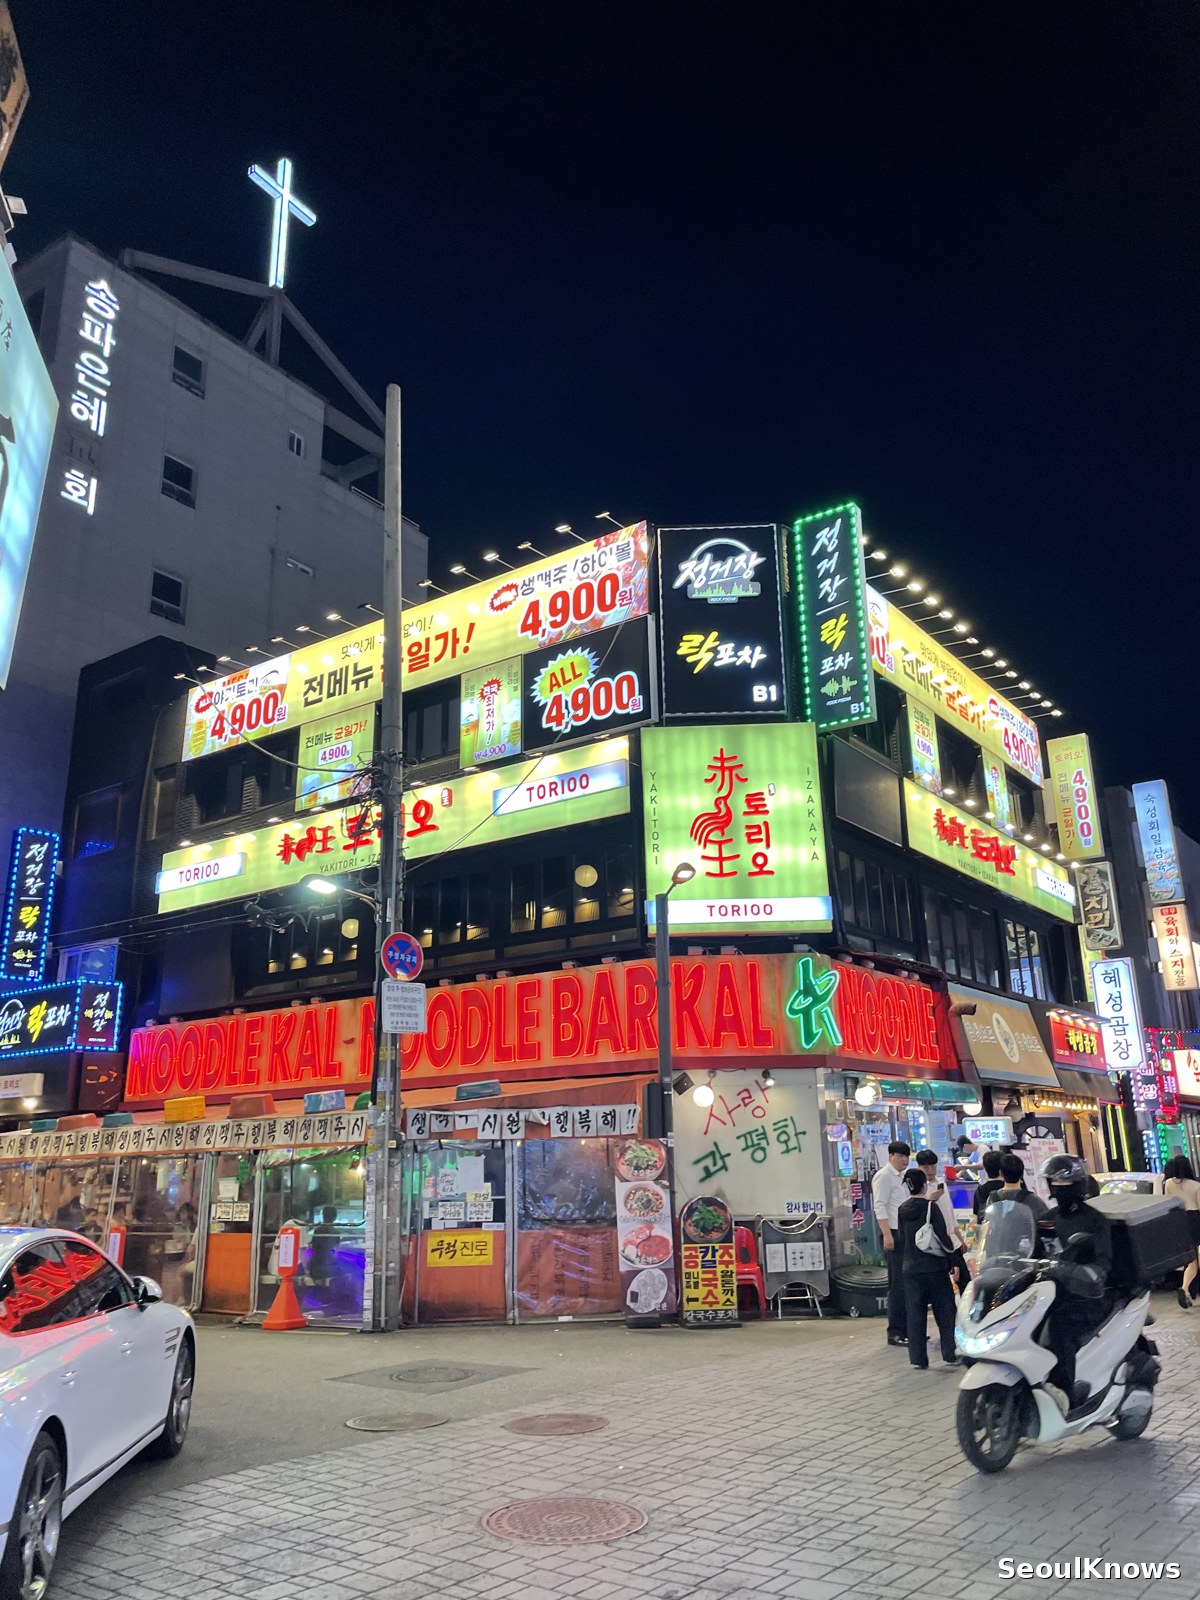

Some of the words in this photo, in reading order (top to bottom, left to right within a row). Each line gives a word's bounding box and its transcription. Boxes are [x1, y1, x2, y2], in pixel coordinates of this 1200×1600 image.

[672, 552, 767, 589] 정거장
[811, 517, 849, 603] 정거장
[519, 572, 635, 638] 4,900원
[303, 662, 374, 708] 전메뉴
[548, 661, 583, 694] ALL
[752, 684, 777, 703] B1
[544, 674, 642, 731] 4,900원
[850, 701, 865, 714] B1
[305, 730, 333, 749] 전메뉴
[526, 771, 590, 803] TORIOO
[649, 771, 660, 865] YAKITORI
[742, 791, 776, 877] 토리오
[804, 766, 820, 861] IZAKAYA
[24, 841, 50, 895] 정거장
[178, 862, 220, 883] TORIOO
[319, 857, 358, 875] YAKITORI
[706, 903, 774, 917] TORIOO
[29, 969, 39, 977] B1
[387, 950, 418, 964] 주정차금지
[126, 1016, 264, 1098] NOODLE
[265, 1005, 341, 1084] KAL
[551, 963, 659, 1060] BAR
[671, 960, 775, 1051] KAL
[836, 964, 941, 1063] NOODLE
[1100, 967, 1132, 1061] 혜성곱창
[703, 1079, 772, 1136] 사랑
[459, 1240, 489, 1257] 진로
